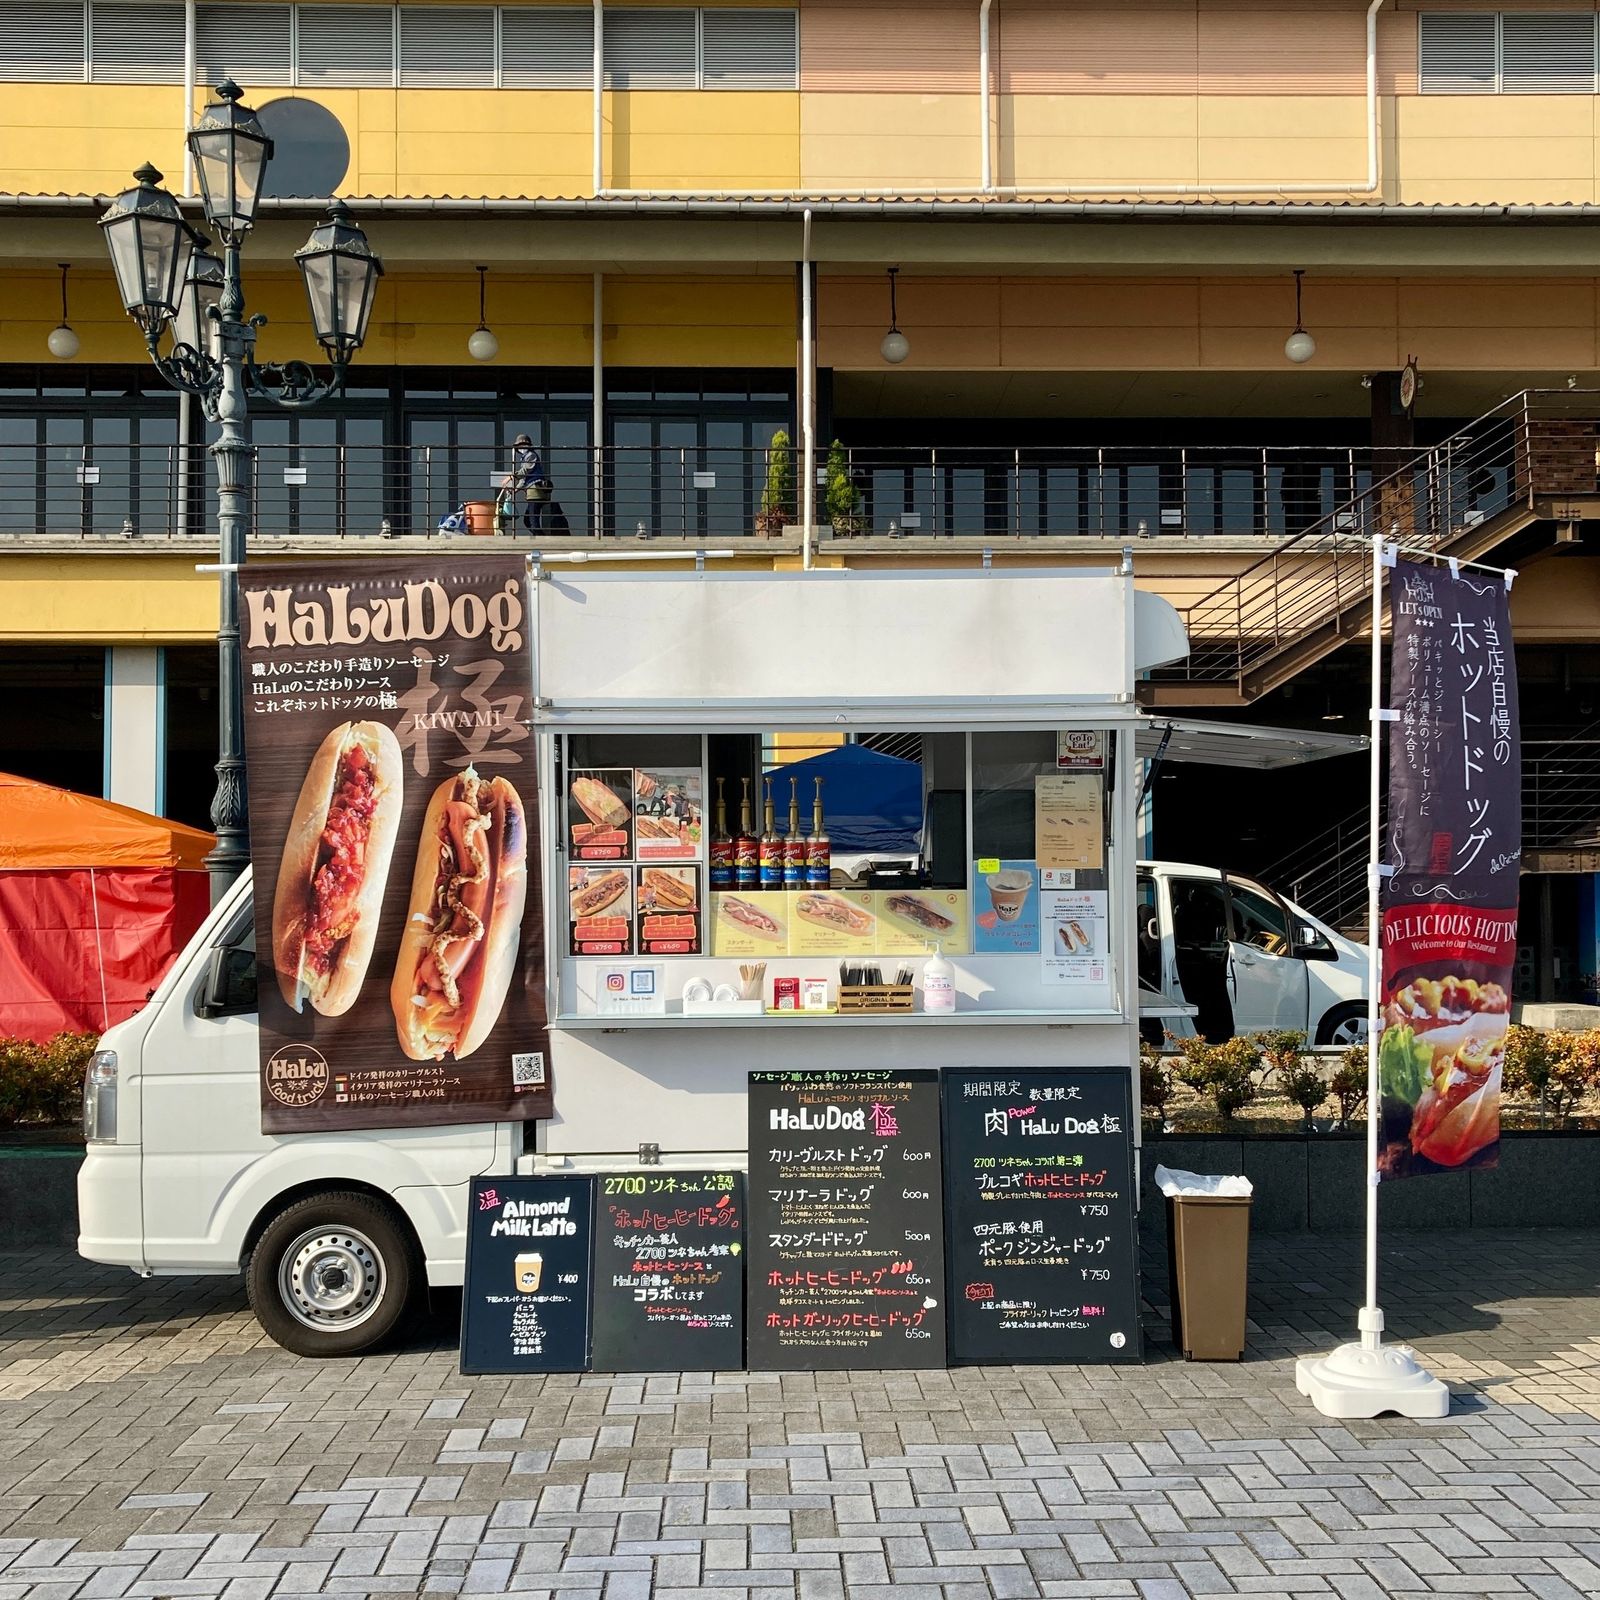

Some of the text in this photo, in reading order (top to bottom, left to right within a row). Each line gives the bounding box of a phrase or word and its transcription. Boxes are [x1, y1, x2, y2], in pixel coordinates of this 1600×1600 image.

[245, 579, 523, 652] HaLuDog
[1423, 604, 1443, 619] OPEN
[251, 654, 450, 677] 職人のこだわり手造りソーセージ
[252, 676, 391, 696] HaLuのこだわりソース
[1482, 617, 1512, 766] 当店自慢の
[254, 691, 398, 713] これぞホットドッグの極
[1403, 633, 1420, 770] 特製ソースが絡み合う。
[1450, 612, 1493, 876] ホットドッグ
[1385, 914, 1472, 945] DELICIOUS
[1474, 919, 1501, 942] HOT
[1411, 940, 1445, 951] Welcome
[1454, 941, 1467, 950] Our
[1467, 942, 1497, 954] Restaurant
[271, 1058, 326, 1080] HaLu
[350, 1067, 444, 1081] ドイツ発祥のカリーヴルスト
[271, 1080, 325, 1104] food truck
[350, 1077, 461, 1091] イタリア発祥のマリナーラソース
[963, 1080, 1082, 1101] 期間限定 数量限定
[350, 1088, 445, 1101] 日本のソーセージ職人の技
[1008, 1104, 1037, 1119] Power
[984, 1108, 1009, 1137] 肉
[1021, 1118, 1060, 1136] HaLu
[902, 1149, 931, 1162] 600円
[604, 1176, 646, 1195] 2700
[902, 1188, 929, 1200] 600円
[479, 1189, 501, 1211] 温
[502, 1197, 571, 1219] Almond
[1080, 1204, 1109, 1216] ¥750
[491, 1218, 577, 1237] Milk Latte
[905, 1230, 931, 1241] 500円
[557, 1274, 579, 1285] ¥400
[905, 1273, 931, 1285] 650円
[1080, 1269, 1110, 1281] ¥750
[905, 1328, 931, 1339] 650円
